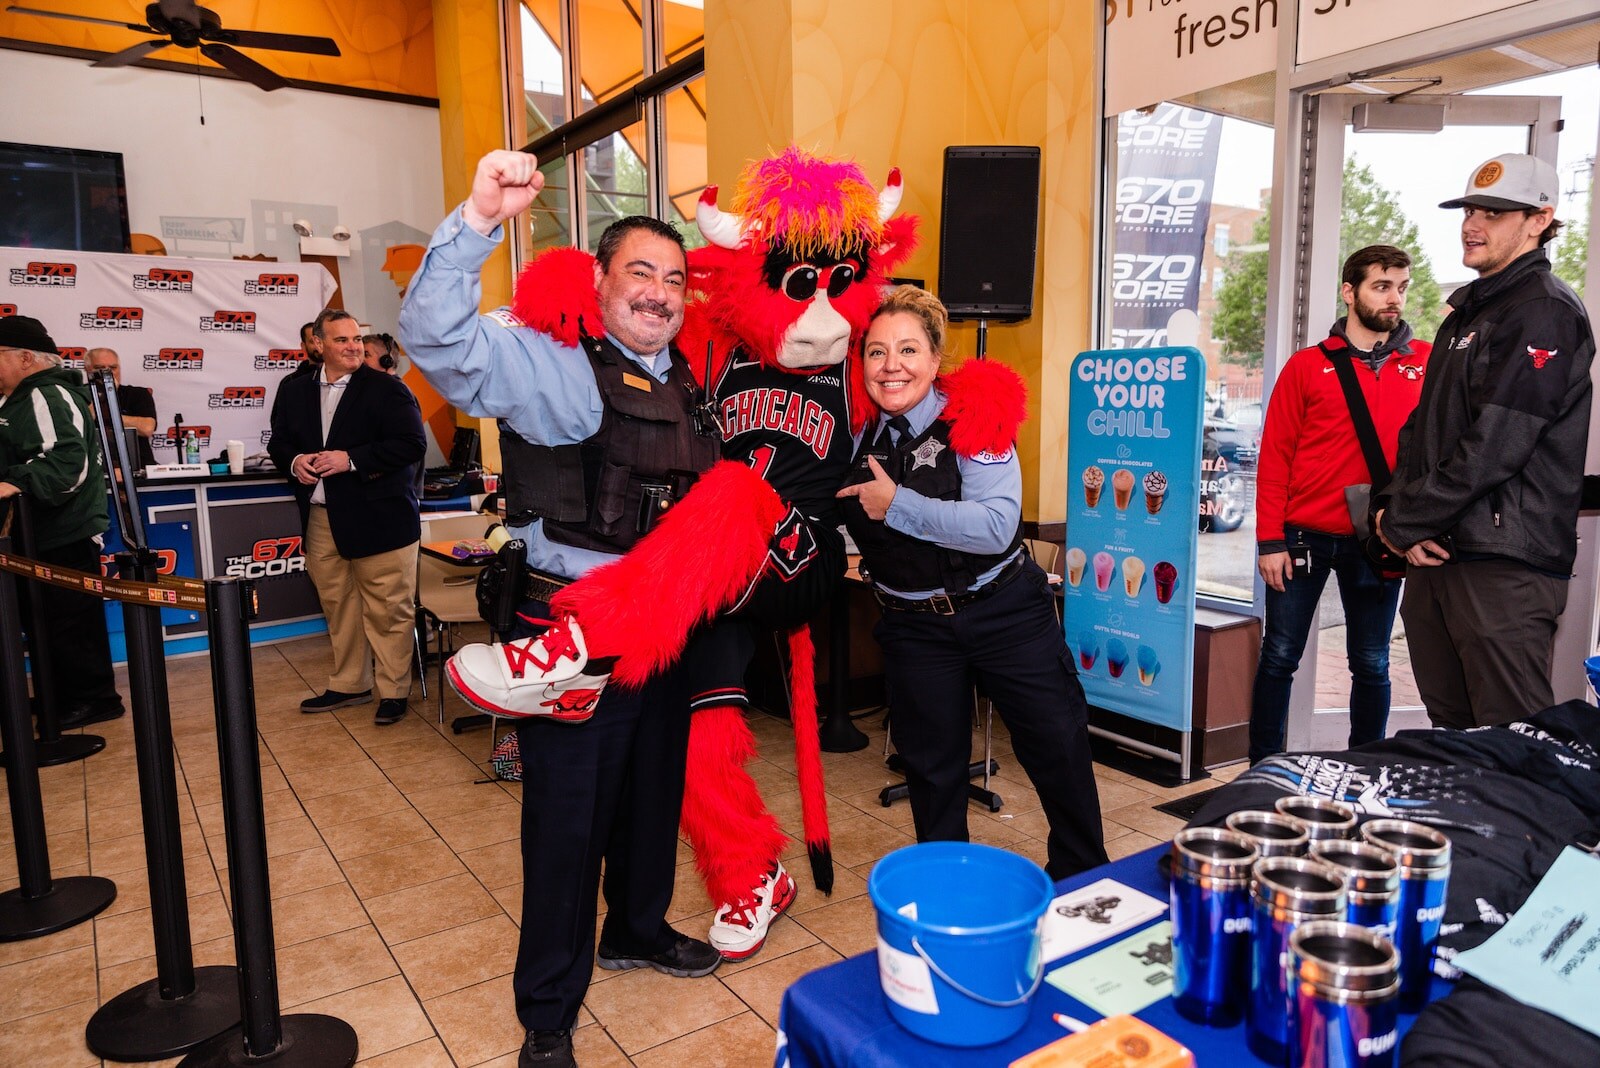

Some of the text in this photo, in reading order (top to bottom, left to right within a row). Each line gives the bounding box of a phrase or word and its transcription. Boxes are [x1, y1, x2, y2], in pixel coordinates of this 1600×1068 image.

[1174, 0, 1278, 58] fresh
[1117, 125, 1207, 149] CORE
[1116, 176, 1205, 206] 670
[1115, 203, 1198, 226] ORE
[28, 262, 77, 276] 670
[149, 268, 193, 282] 670
[10, 274, 76, 286] SCORE
[134, 280, 193, 291] SCORE
[259, 274, 299, 285] 670
[244, 284, 298, 294] SCORE
[1112, 280, 1188, 300] ORE
[97, 307, 143, 319] 670
[214, 311, 256, 323] 670
[80, 318, 142, 329] SCORE
[200, 321, 256, 332] SCORE
[160, 348, 203, 360] 670
[269, 350, 308, 361] 670
[143, 359, 203, 370] SCORE
[255, 360, 300, 370] SCOR
[1078, 356, 1187, 382] CHOOSE
[224, 387, 266, 399] 670
[1093, 384, 1165, 408] YOUR
[208, 398, 264, 408] SCORE
[721, 388, 835, 460] CHICAGO
[1087, 409, 1171, 438] CHILL
[226, 537, 304, 565] THE 67
[226, 557, 306, 579] SCOR
